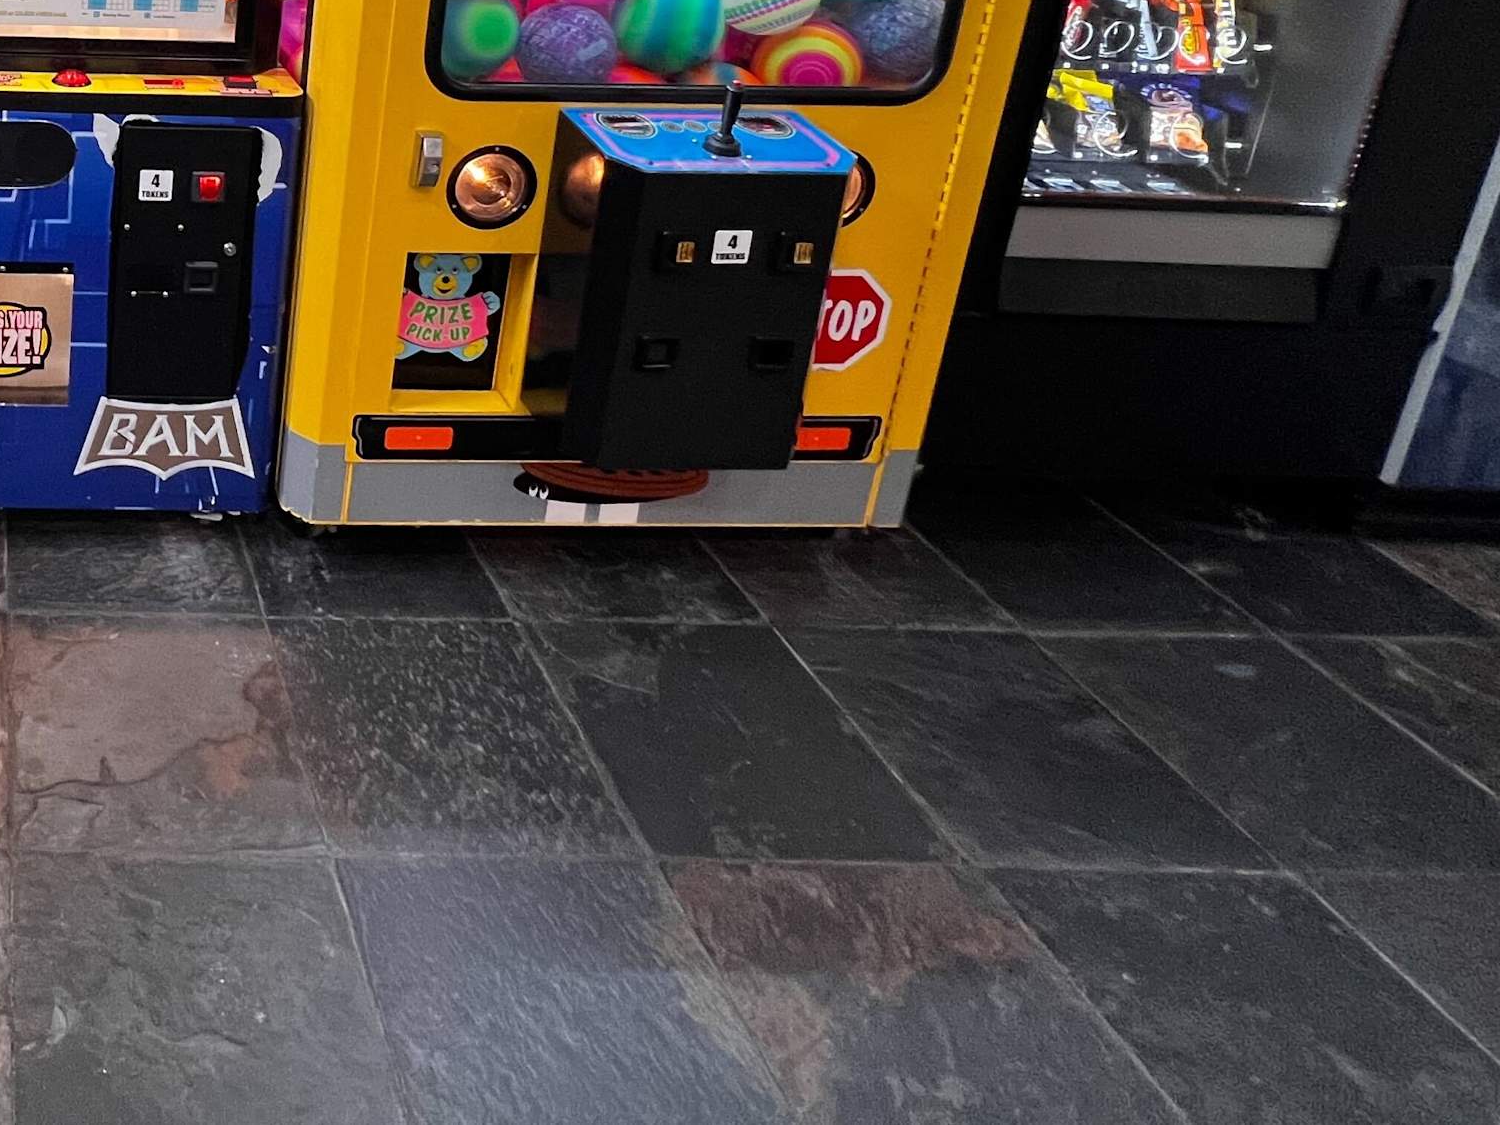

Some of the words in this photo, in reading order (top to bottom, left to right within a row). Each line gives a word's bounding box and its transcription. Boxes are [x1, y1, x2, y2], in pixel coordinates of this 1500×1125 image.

[151, 173, 160, 188] 4
[141, 190, 169, 198] TOKENS
[727, 234, 738, 249] 4
[8, 310, 43, 329] YOUR
[409, 301, 473, 325] PRIZE
[816, 299, 877, 342] TOP
[97, 412, 236, 459] BAM
